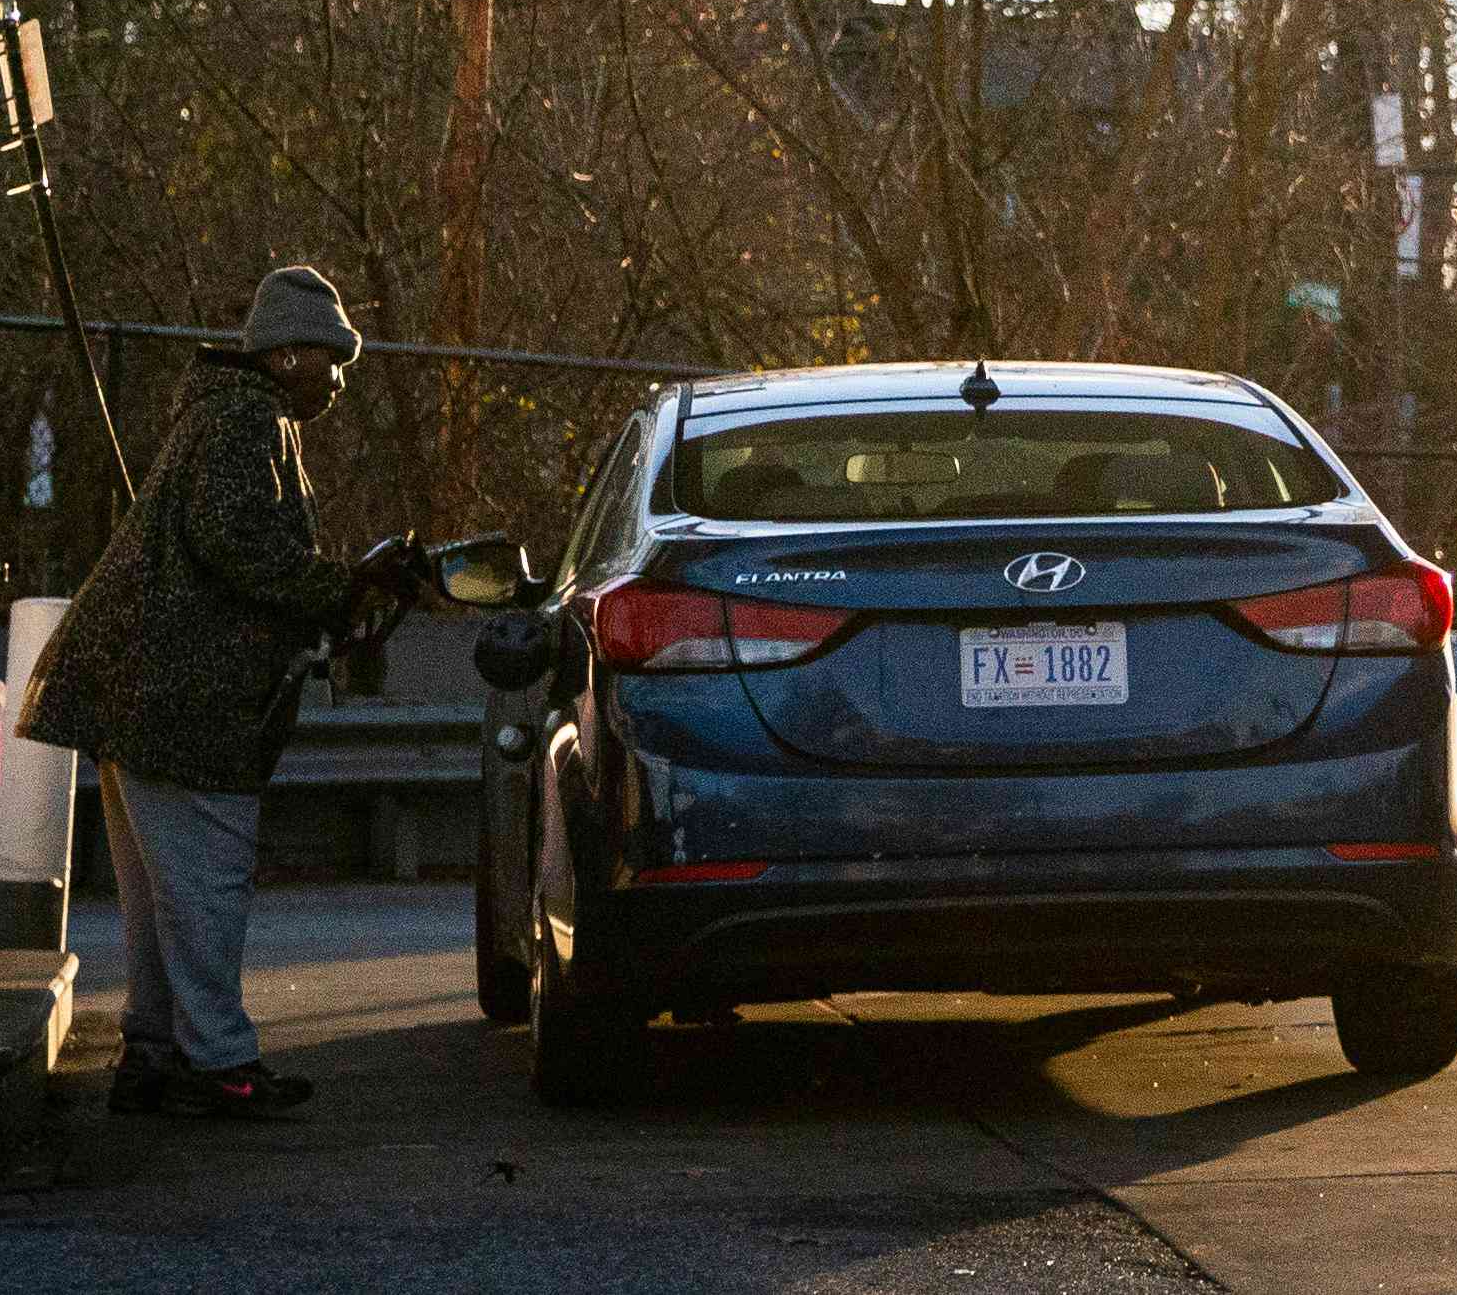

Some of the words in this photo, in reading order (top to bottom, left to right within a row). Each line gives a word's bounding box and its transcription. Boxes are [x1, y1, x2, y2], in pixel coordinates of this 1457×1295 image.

[735, 570, 847, 585] ELANTRA
[973, 646, 1010, 684] FX
[1044, 644, 1111, 683] 1882
